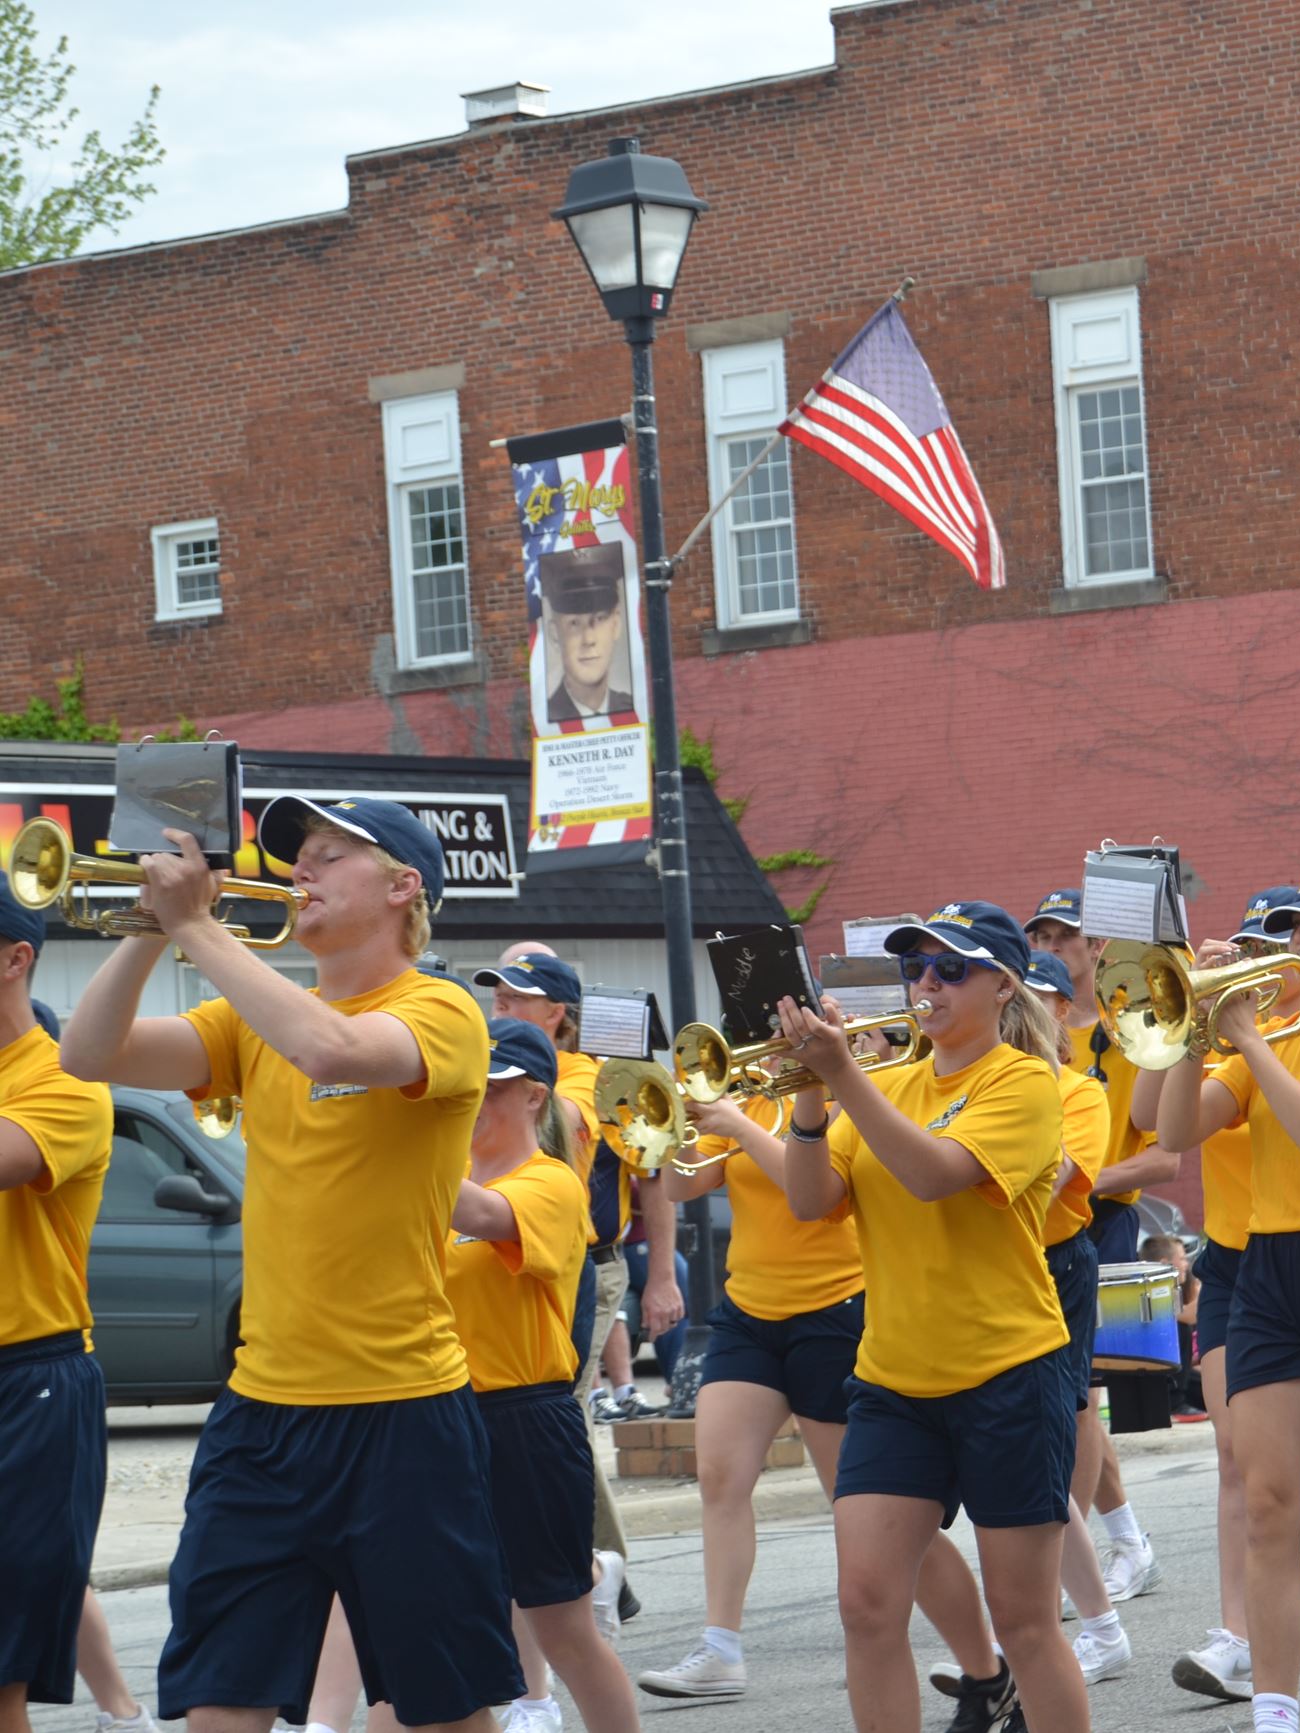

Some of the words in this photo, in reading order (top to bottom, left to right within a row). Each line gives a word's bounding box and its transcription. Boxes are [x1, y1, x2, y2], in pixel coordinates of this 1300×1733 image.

[548, 749, 600, 767] KENNETH
[602, 748, 612, 760] R.
[614, 745, 635, 758] DAY
[474, 811, 494, 841] &
